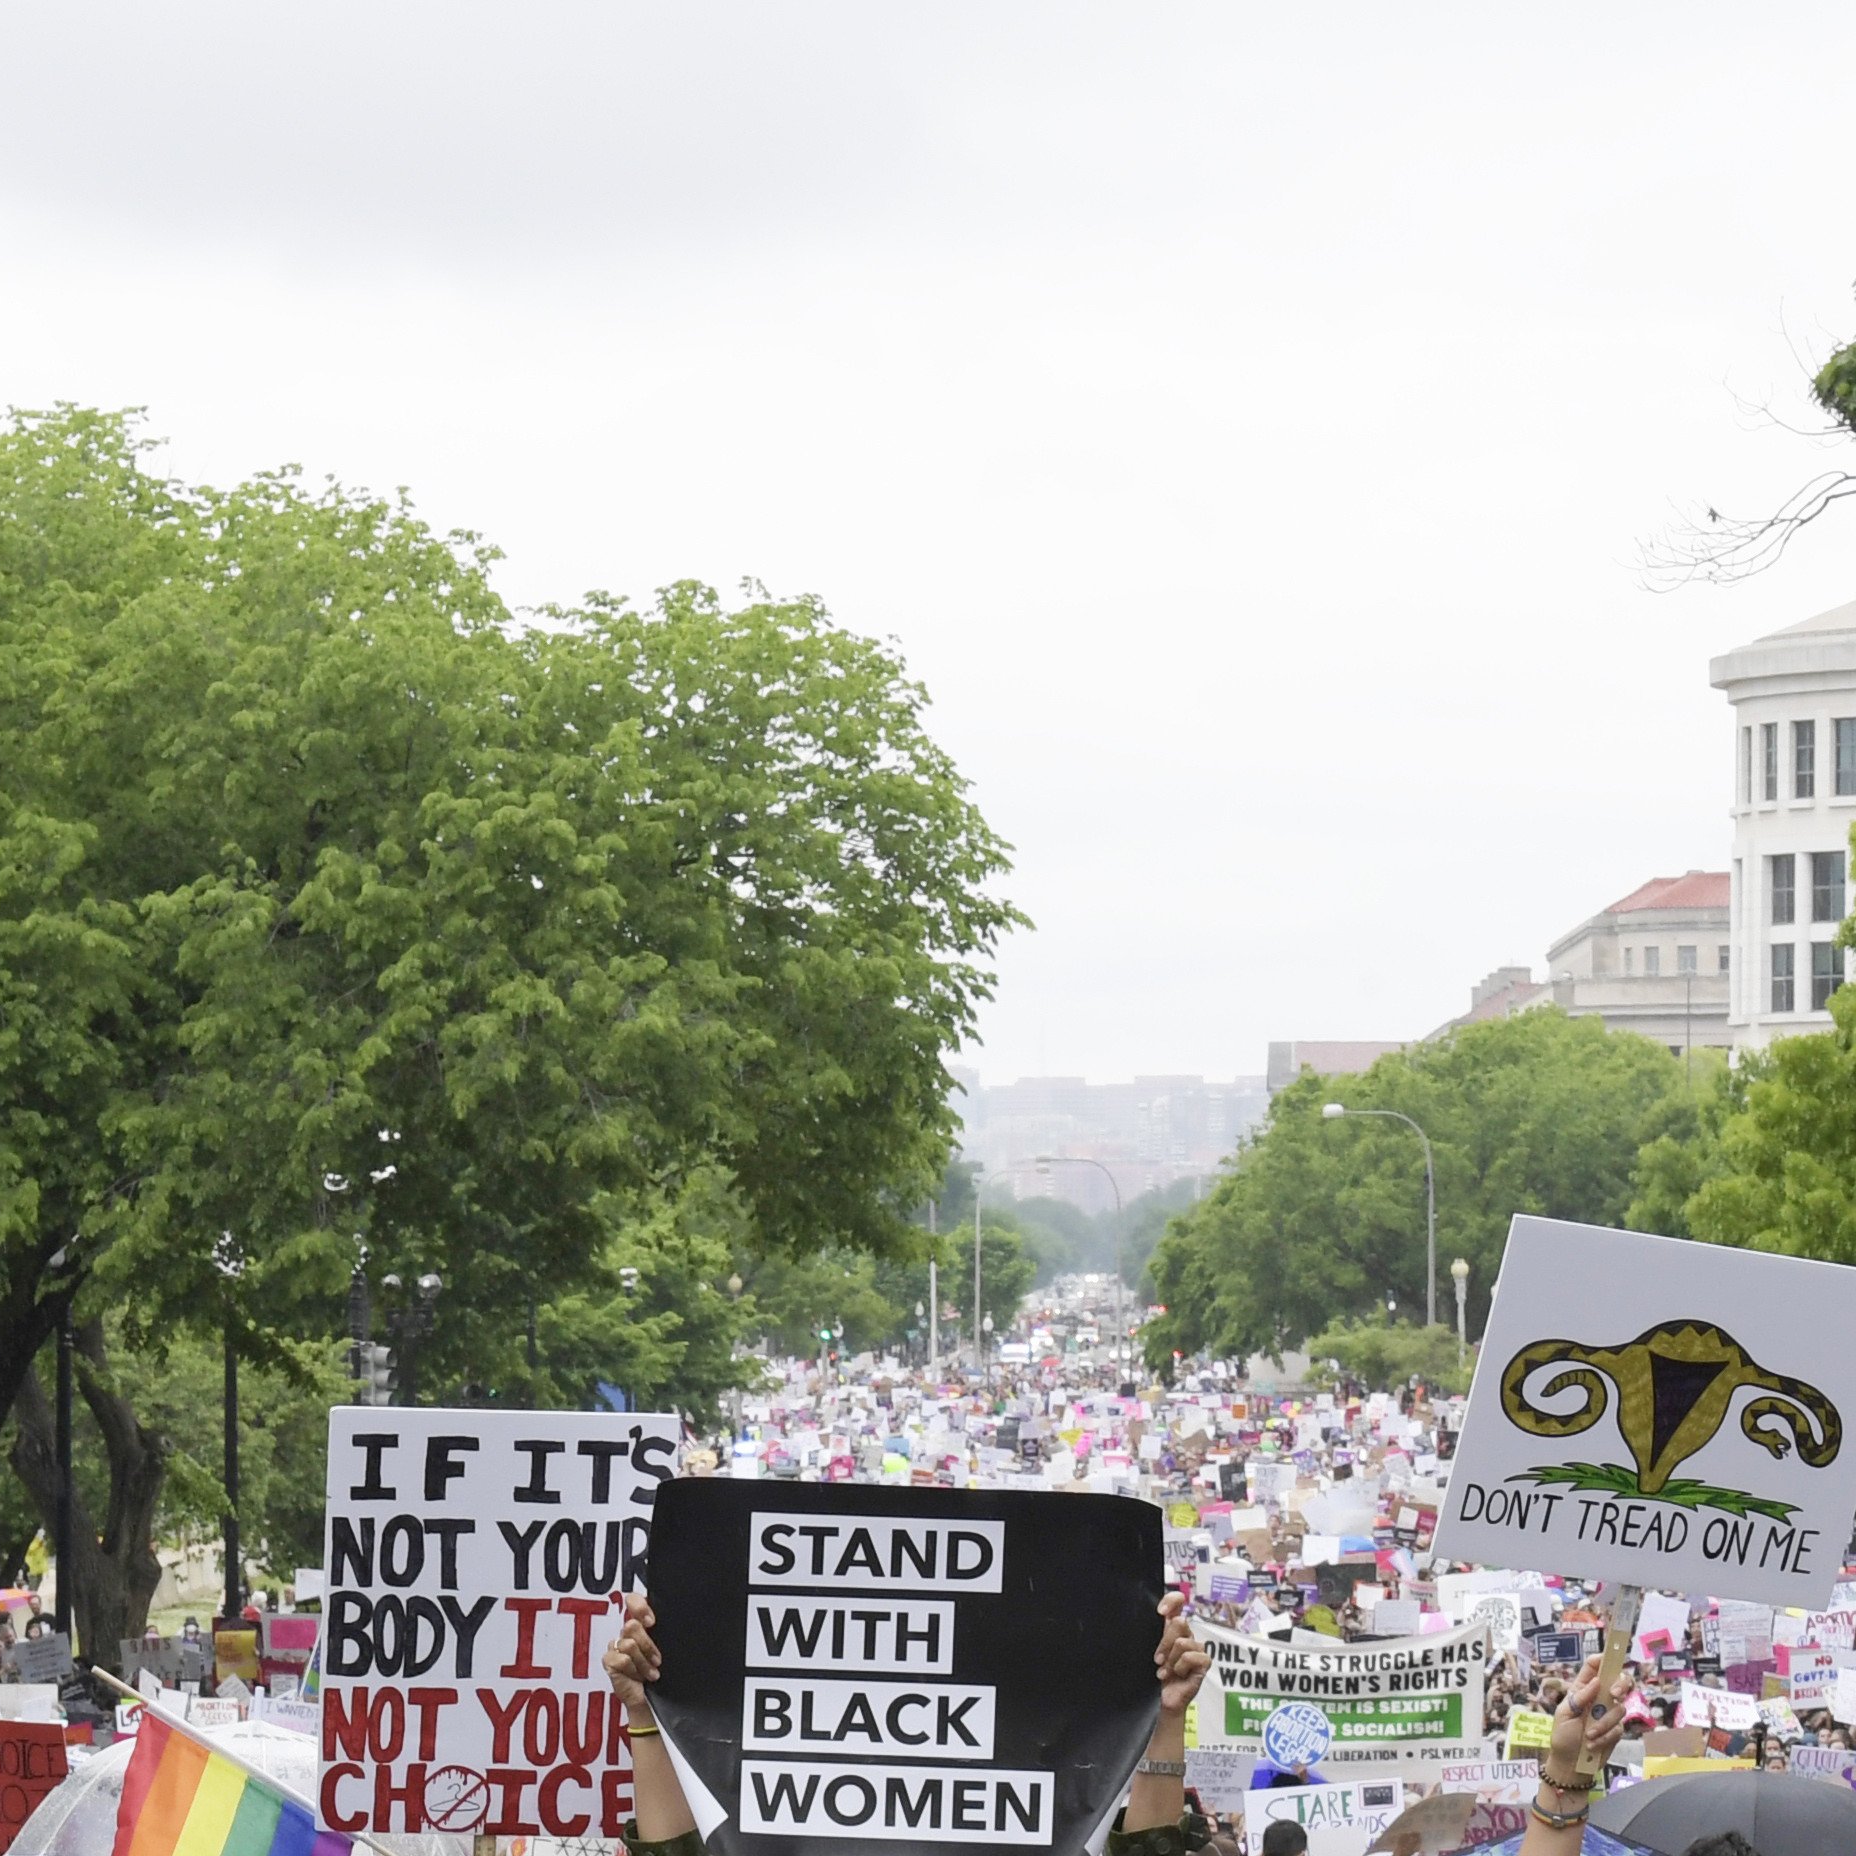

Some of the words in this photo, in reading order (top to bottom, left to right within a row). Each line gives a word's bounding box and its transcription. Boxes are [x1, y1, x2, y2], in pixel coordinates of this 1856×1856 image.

[352, 1432, 481, 1502] IF
[513, 1426, 678, 1506] IT'S
[330, 1514, 476, 1590] NOT
[497, 1513, 649, 1594] YOUR
[759, 1522, 993, 1581] STAND
[1459, 1483, 1563, 1533] DON'T
[1578, 1500, 1688, 1554] TREAD
[1702, 1517, 1754, 1566] ON
[1760, 1528, 1820, 1575] ME
[326, 1594, 496, 1679] BODY
[500, 1594, 626, 1680] IT'
[756, 1606, 940, 1664] WITH
[1204, 1640, 1259, 1666] ONLY
[1271, 1650, 1310, 1670] THE
[1320, 1646, 1434, 1674] STRUGGLE
[1441, 1640, 1483, 1663] HAS
[1815, 1656, 1832, 1666] NO
[1219, 1667, 1269, 1690] WON
[1278, 1673, 1381, 1695] WOMEN'S
[1389, 1667, 1468, 1692] RIGHTS
[1239, 1698, 1273, 1711] THE
[1356, 1701, 1374, 1714] IS
[1378, 1698, 1449, 1714] SEXIST!
[322, 1686, 479, 1766] NOT
[476, 1686, 631, 1768] YOUR
[752, 1691, 983, 1750] BLACK
[1341, 1720, 1444, 1737] SOCIALISM!
[1333, 1750, 1398, 1761] LIBERATION
[1421, 1747, 1481, 1760] PSLWEB.OR
[1443, 1765, 1485, 1781] RESPECT
[750, 1773, 1042, 1833] WOMEN
